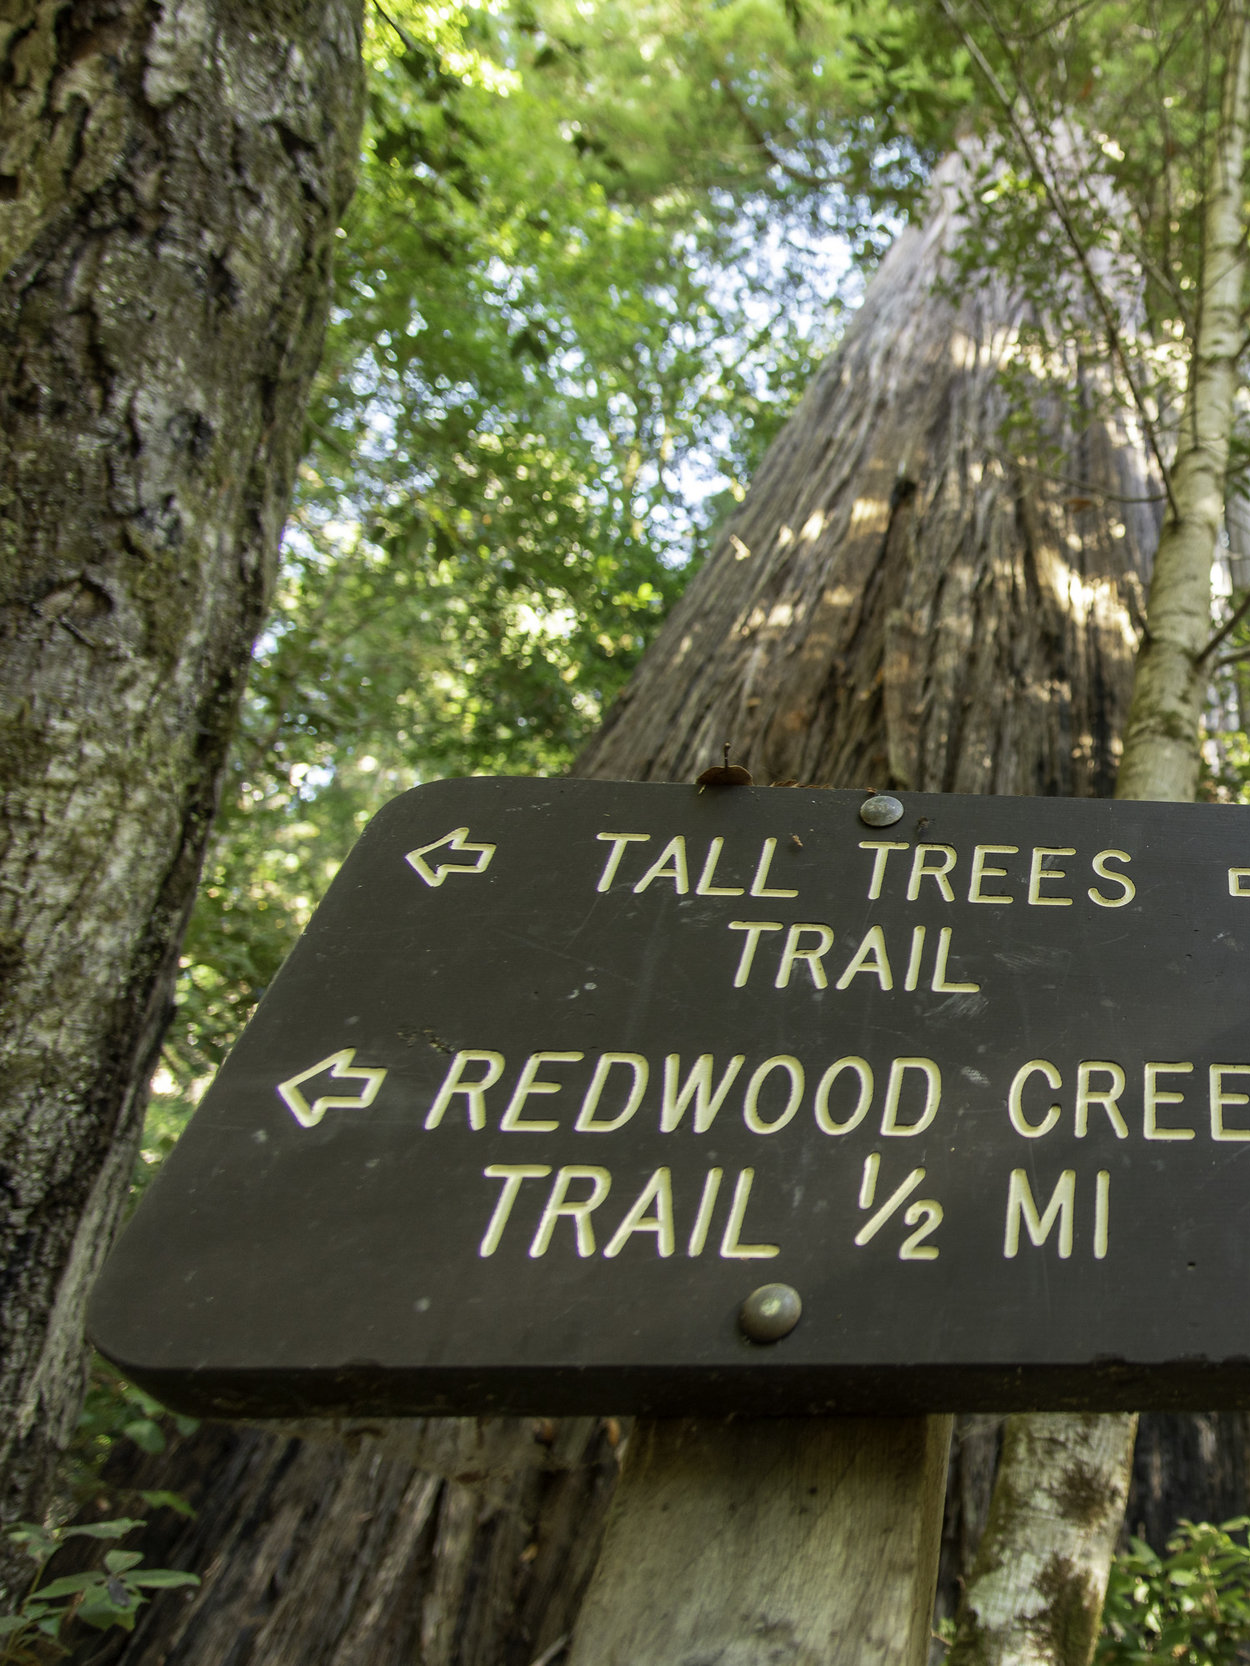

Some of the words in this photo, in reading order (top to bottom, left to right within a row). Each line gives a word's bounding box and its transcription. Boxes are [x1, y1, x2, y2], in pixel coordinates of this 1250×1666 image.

[596, 832, 798, 897] TALL
[859, 841, 1137, 908] TREES
[728, 920, 980, 994] TRAIL
[424, 1049, 943, 1137] REDWOOD
[480, 1165, 780, 1259] TRAIL
[1003, 1168, 1110, 1260] MI
